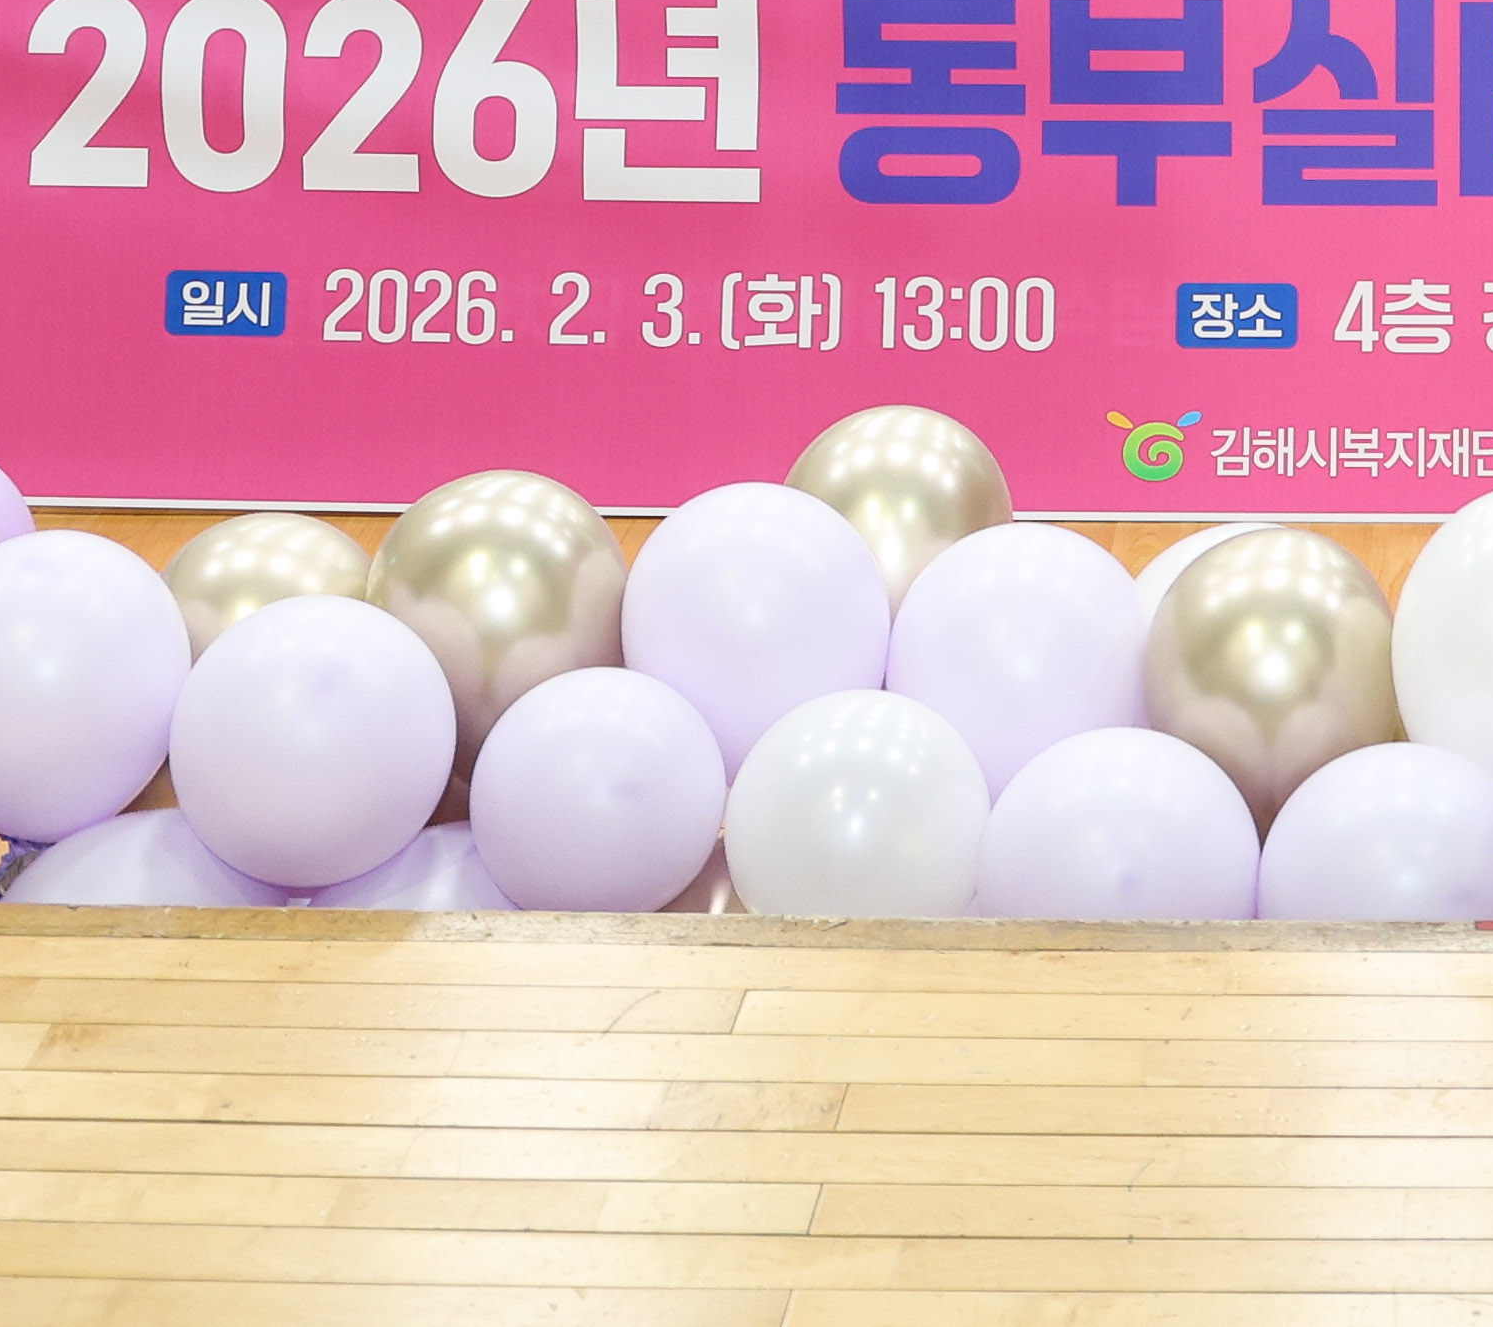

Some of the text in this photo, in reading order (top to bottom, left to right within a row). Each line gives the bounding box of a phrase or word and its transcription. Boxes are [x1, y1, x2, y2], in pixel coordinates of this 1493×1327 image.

[179, 279, 273, 329] 일시
[321, 268, 515, 346] 2026.
[549, 272, 606, 347] 2.
[873, 275, 1057, 352] 13:00
[1189, 292, 1284, 341] 장소
[1334, 278, 1456, 355] 4층
